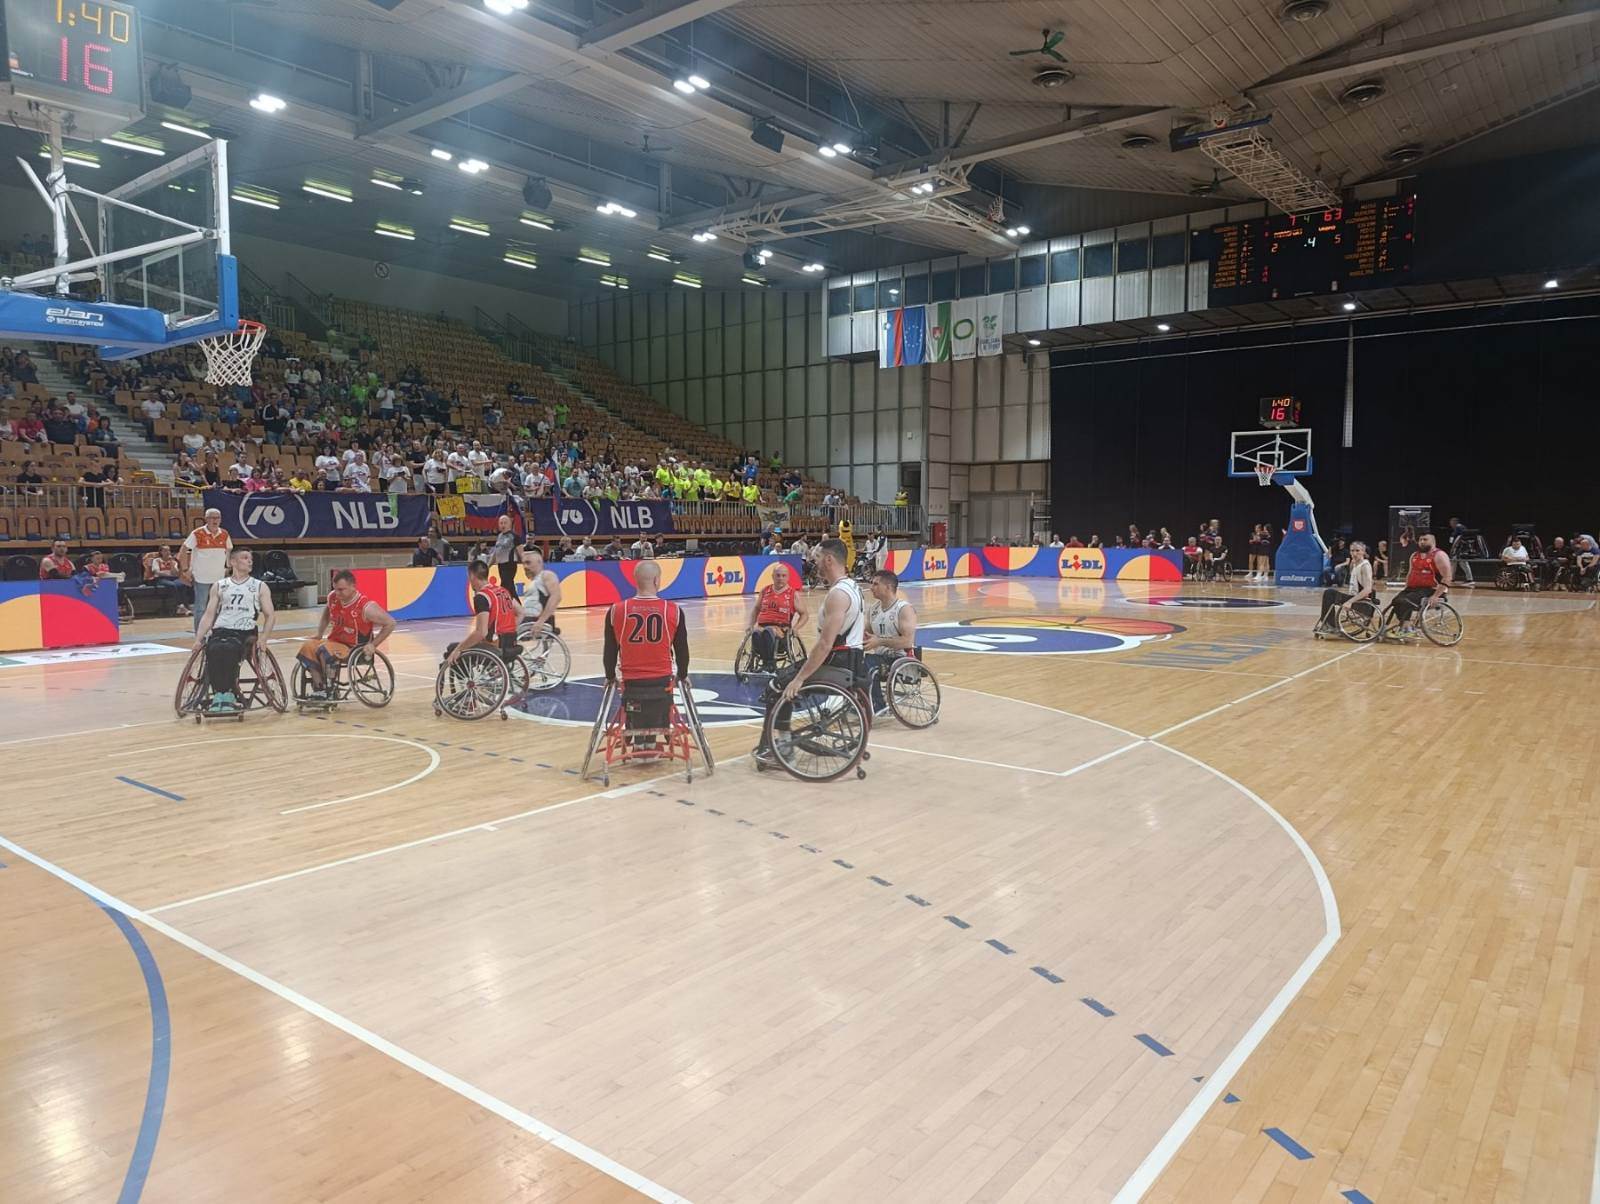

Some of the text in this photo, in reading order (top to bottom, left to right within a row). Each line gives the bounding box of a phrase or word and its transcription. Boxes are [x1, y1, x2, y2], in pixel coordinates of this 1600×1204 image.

[56, 0, 129, 43] 1:40
[60, 36, 113, 94] 16
[1324, 208, 1343, 221] 63
[1271, 243, 1279, 253] 2
[46, 307, 104, 321] elan
[1271, 408, 1285, 420] 16
[332, 501, 399, 529] NLB
[610, 506, 654, 529] NLB
[1279, 574, 1315, 582] elan
[230, 593, 244, 605] 77
[627, 612, 664, 644] 20
